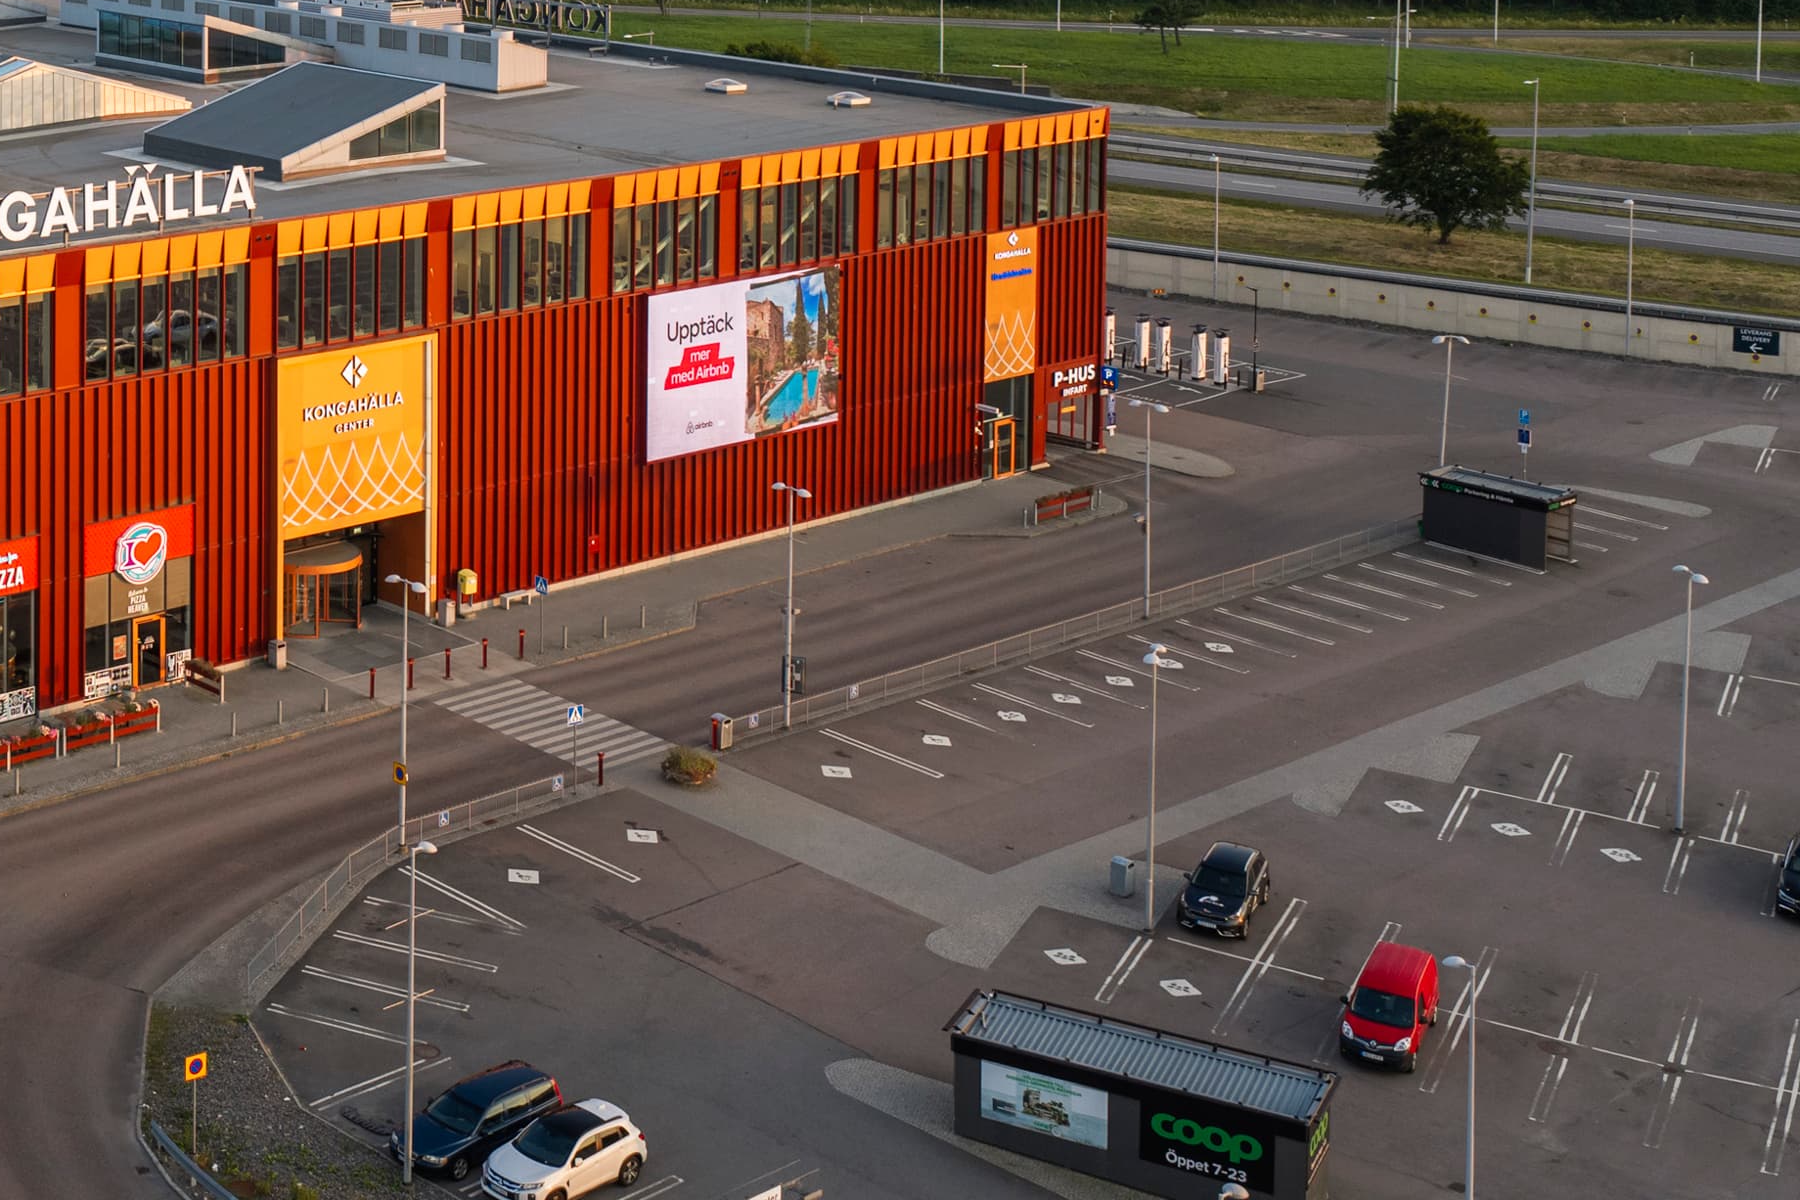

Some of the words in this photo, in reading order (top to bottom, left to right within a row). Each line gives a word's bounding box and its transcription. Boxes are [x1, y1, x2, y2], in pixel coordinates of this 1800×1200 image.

[667, 312, 734, 345] Upptäck
[690, 349, 711, 363] mer
[671, 367, 695, 385] med
[696, 362, 730, 379] Airbnb
[1053, 364, 1096, 388] P-HUS
[303, 392, 405, 423] KONGAHÄLLA
[335, 418, 375, 434] CENTER
[1151, 1113, 1263, 1164] coop
[1165, 1148, 1210, 1174] Öppet
[1212, 1163, 1248, 1183] 7-23
